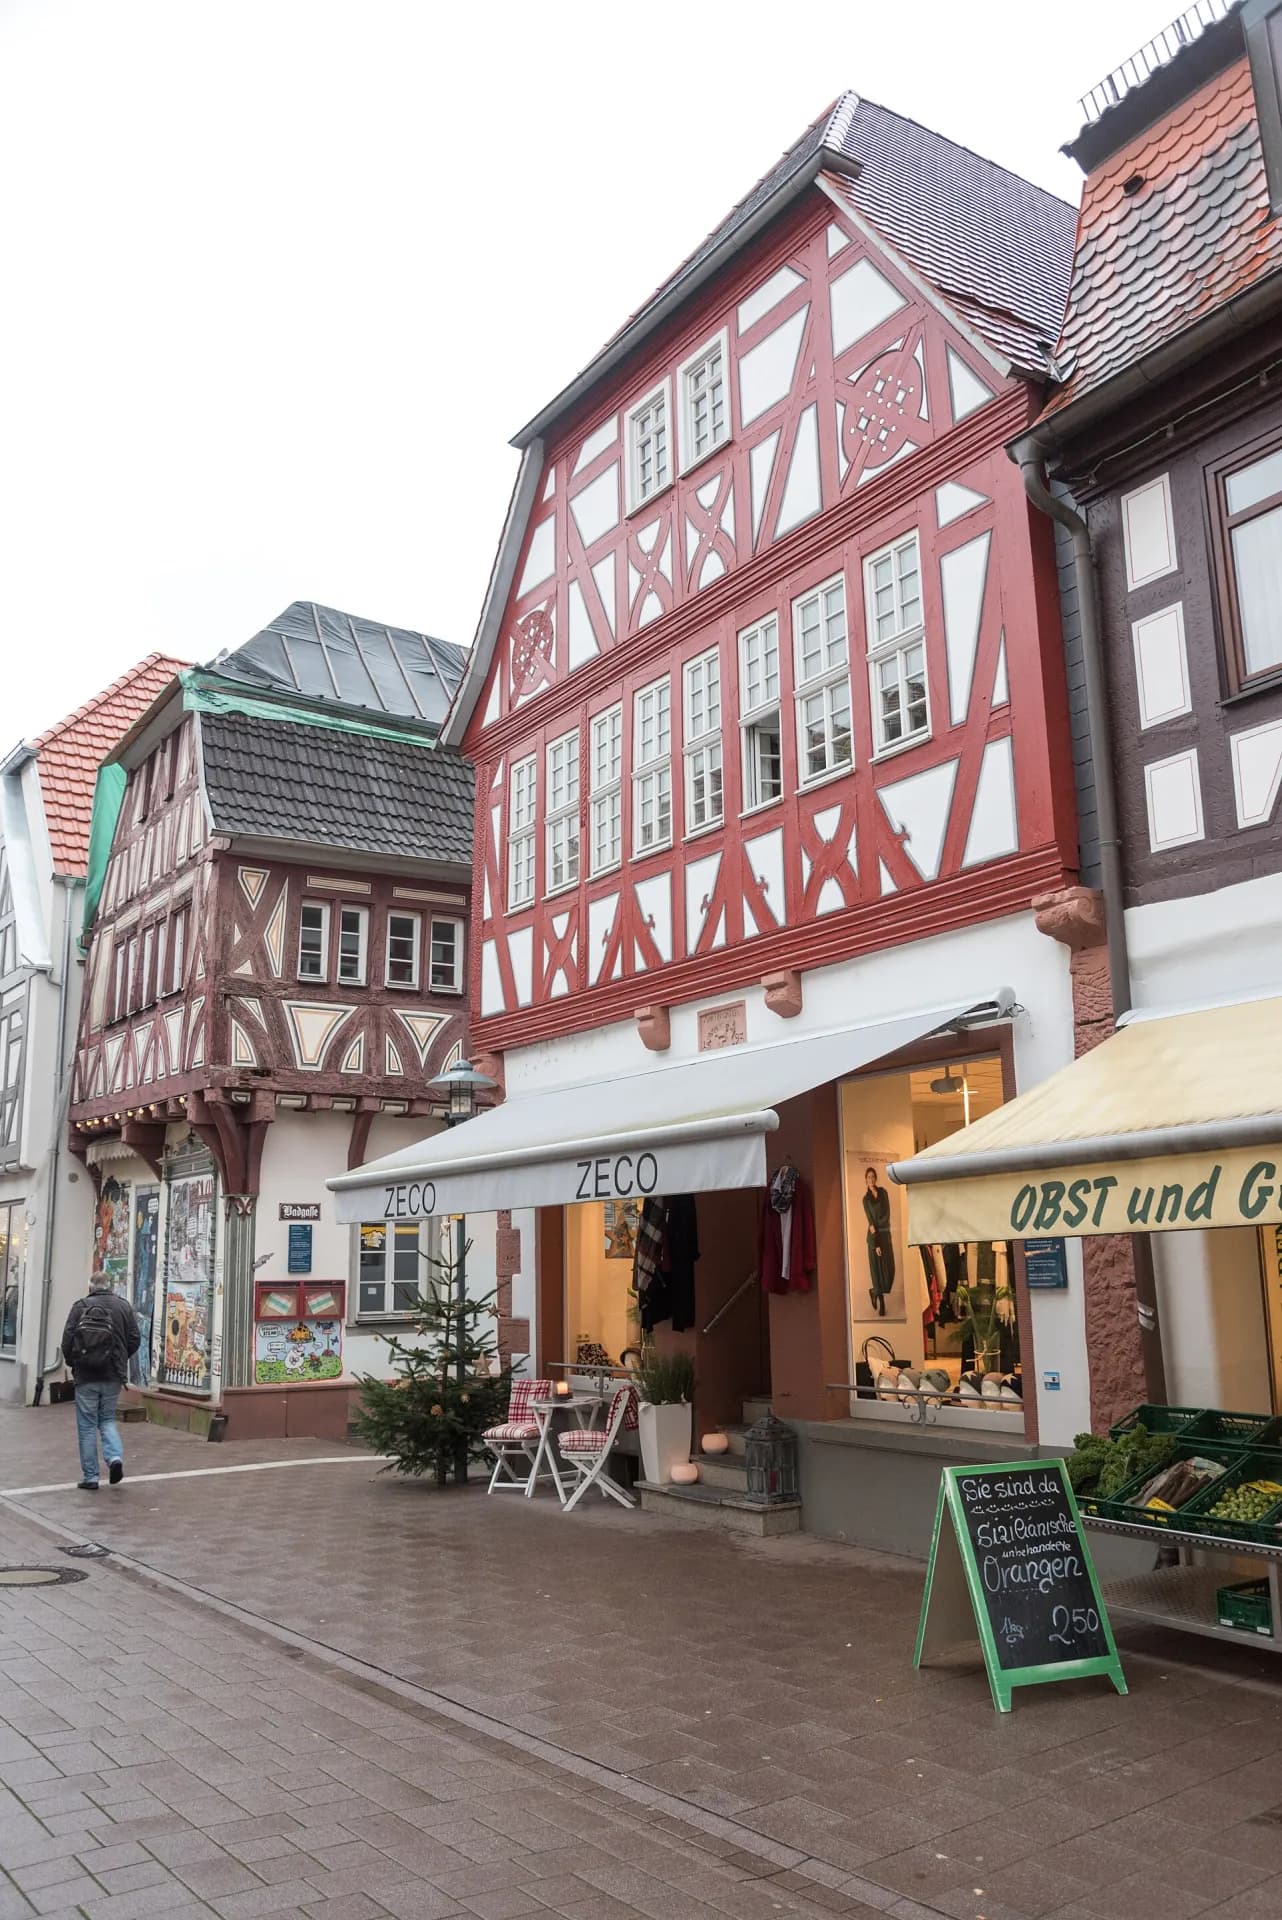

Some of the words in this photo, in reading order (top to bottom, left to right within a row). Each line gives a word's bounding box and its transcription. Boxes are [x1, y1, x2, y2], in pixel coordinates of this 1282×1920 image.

[575, 1152, 658, 1200] ZECO
[384, 1182, 436, 1218] ZECO
[1010, 1175, 1118, 1232] OBST
[1127, 1165, 1222, 1225] und
[1239, 1161, 1282, 1220] G
[962, 1477, 992, 1501] Sie
[994, 1475, 1036, 1499] sind
[1038, 1474, 1060, 1495] da
[1002, 1541, 1072, 1558] unbehandelte
[983, 1555, 1083, 1593] Orangen
